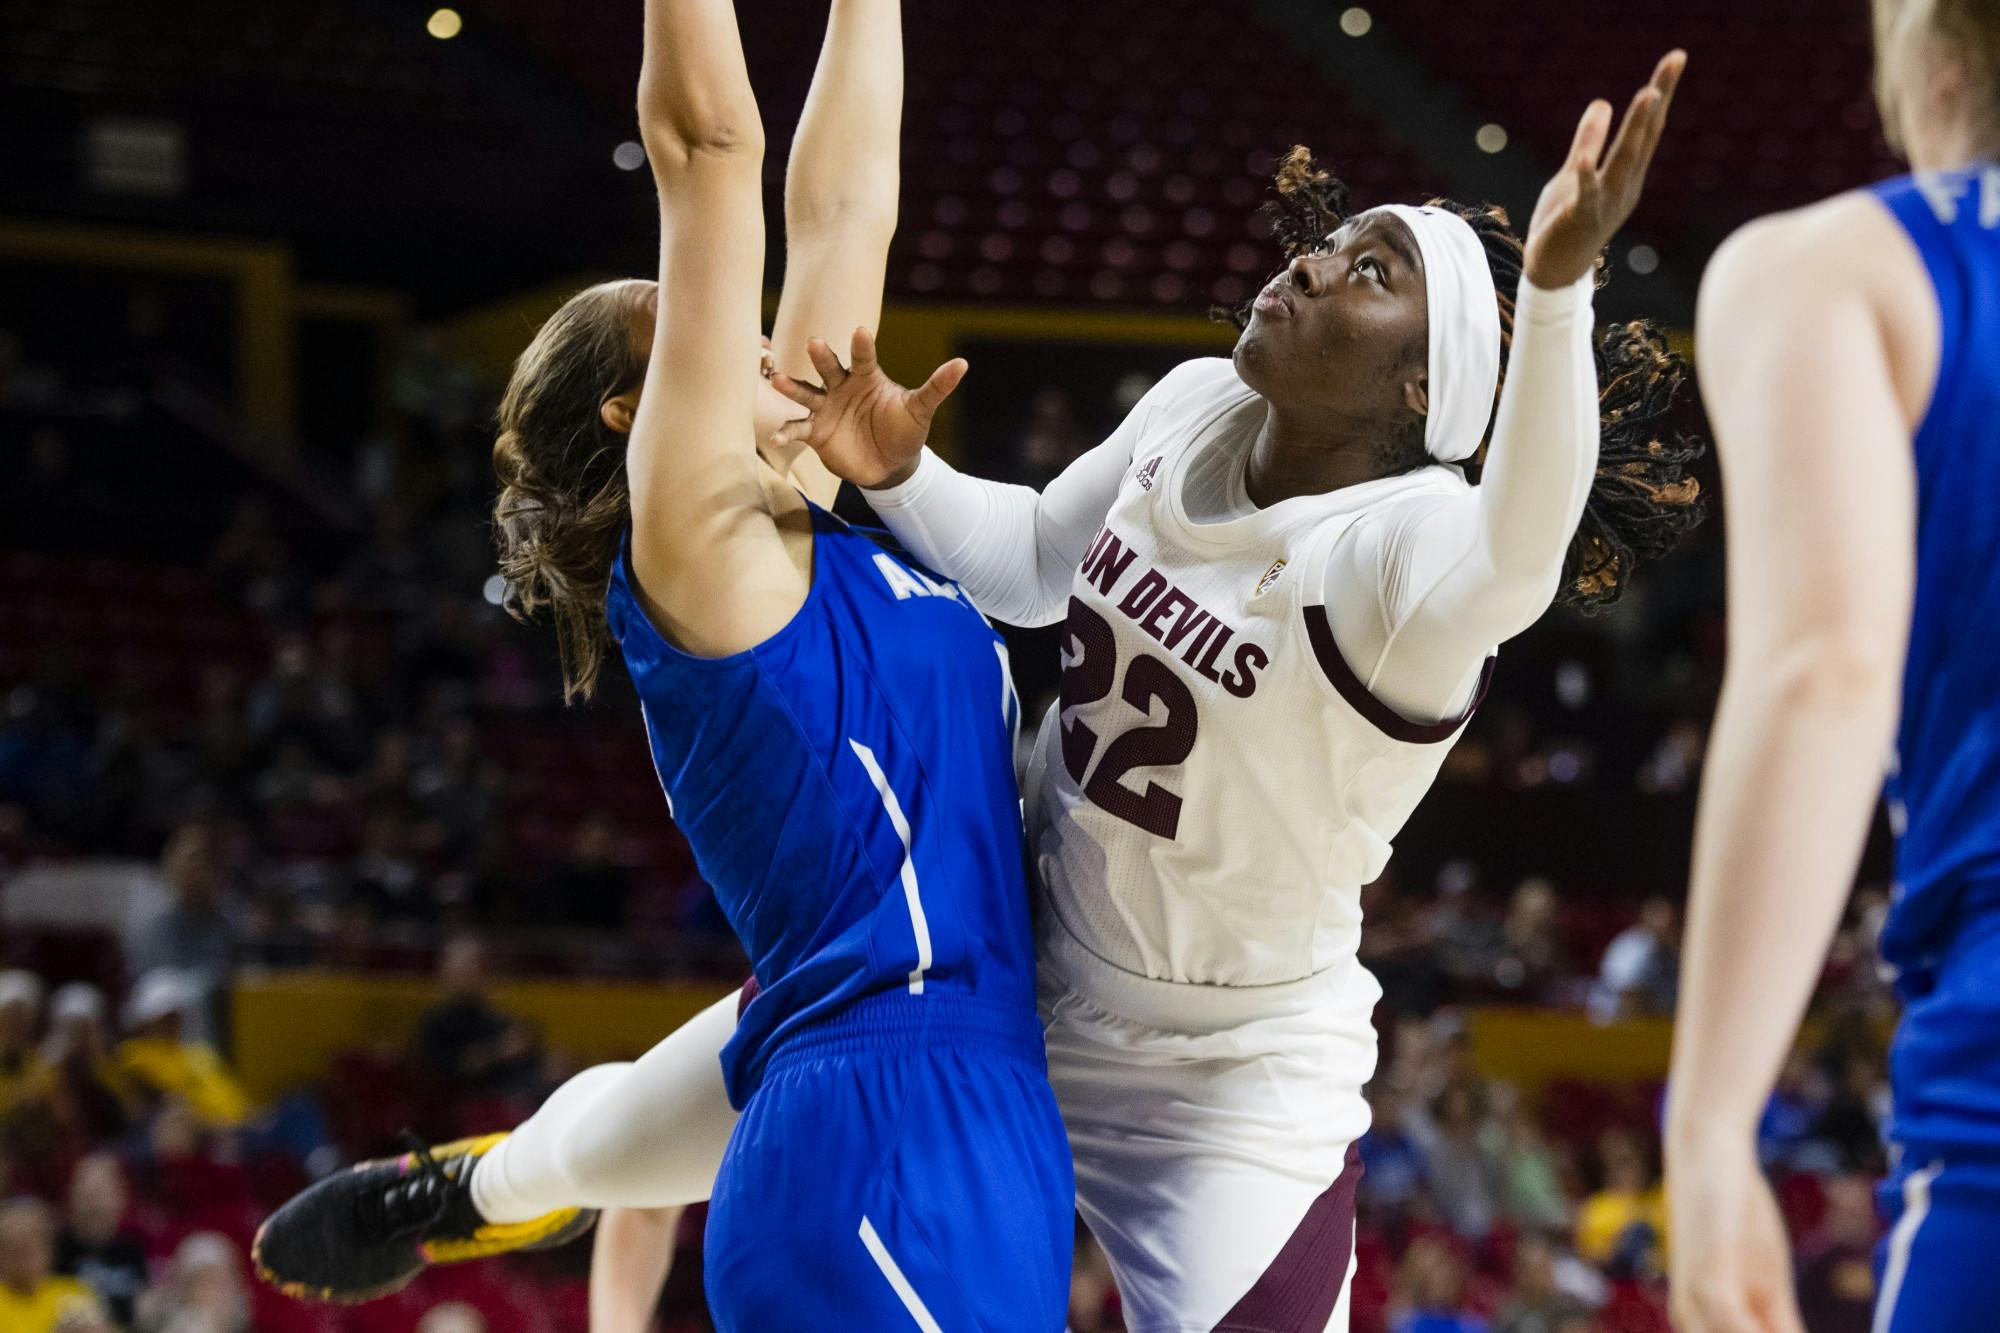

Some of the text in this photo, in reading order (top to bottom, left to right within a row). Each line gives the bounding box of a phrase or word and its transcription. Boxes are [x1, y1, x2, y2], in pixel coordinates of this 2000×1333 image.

[1081, 525, 1139, 597] UN
[1116, 567, 1270, 699] DEVILS
[1059, 594, 1198, 841] 22
